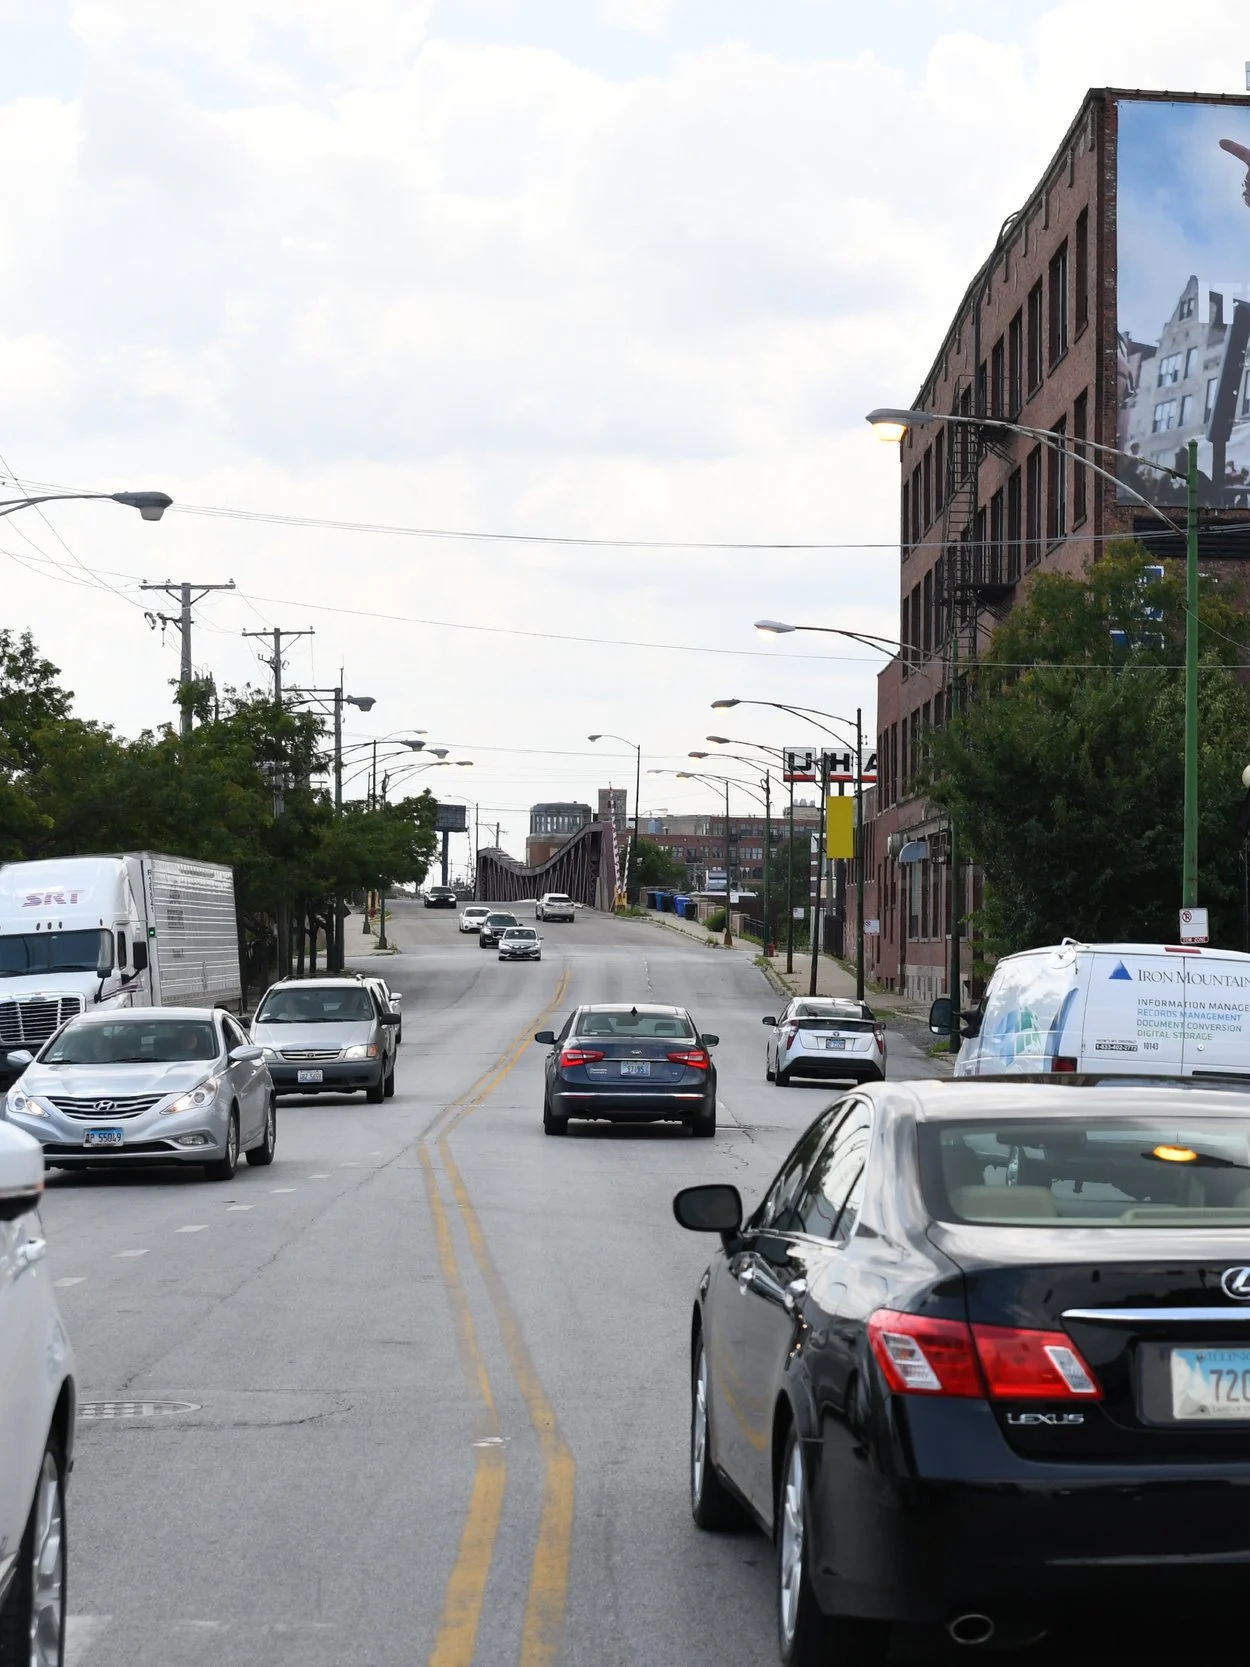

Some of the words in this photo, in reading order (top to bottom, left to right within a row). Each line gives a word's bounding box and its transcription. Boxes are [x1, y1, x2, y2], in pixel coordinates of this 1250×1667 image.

[21, 889, 85, 907] SRT
[1137, 969, 1173, 983] IRON
[1138, 999, 1206, 1009] INFORMATION
[1137, 1008, 1177, 1018] RECORDS
[1180, 1011, 1242, 1021] MANAGEMENT
[1136, 1019, 1184, 1029] DOCUMENT
[1187, 1022, 1242, 1032] CONVERSION
[1137, 1029, 1170, 1039] DIGITAL
[1172, 1031, 1212, 1041] STORAGE
[1006, 1413, 1084, 1425] LEXUS
